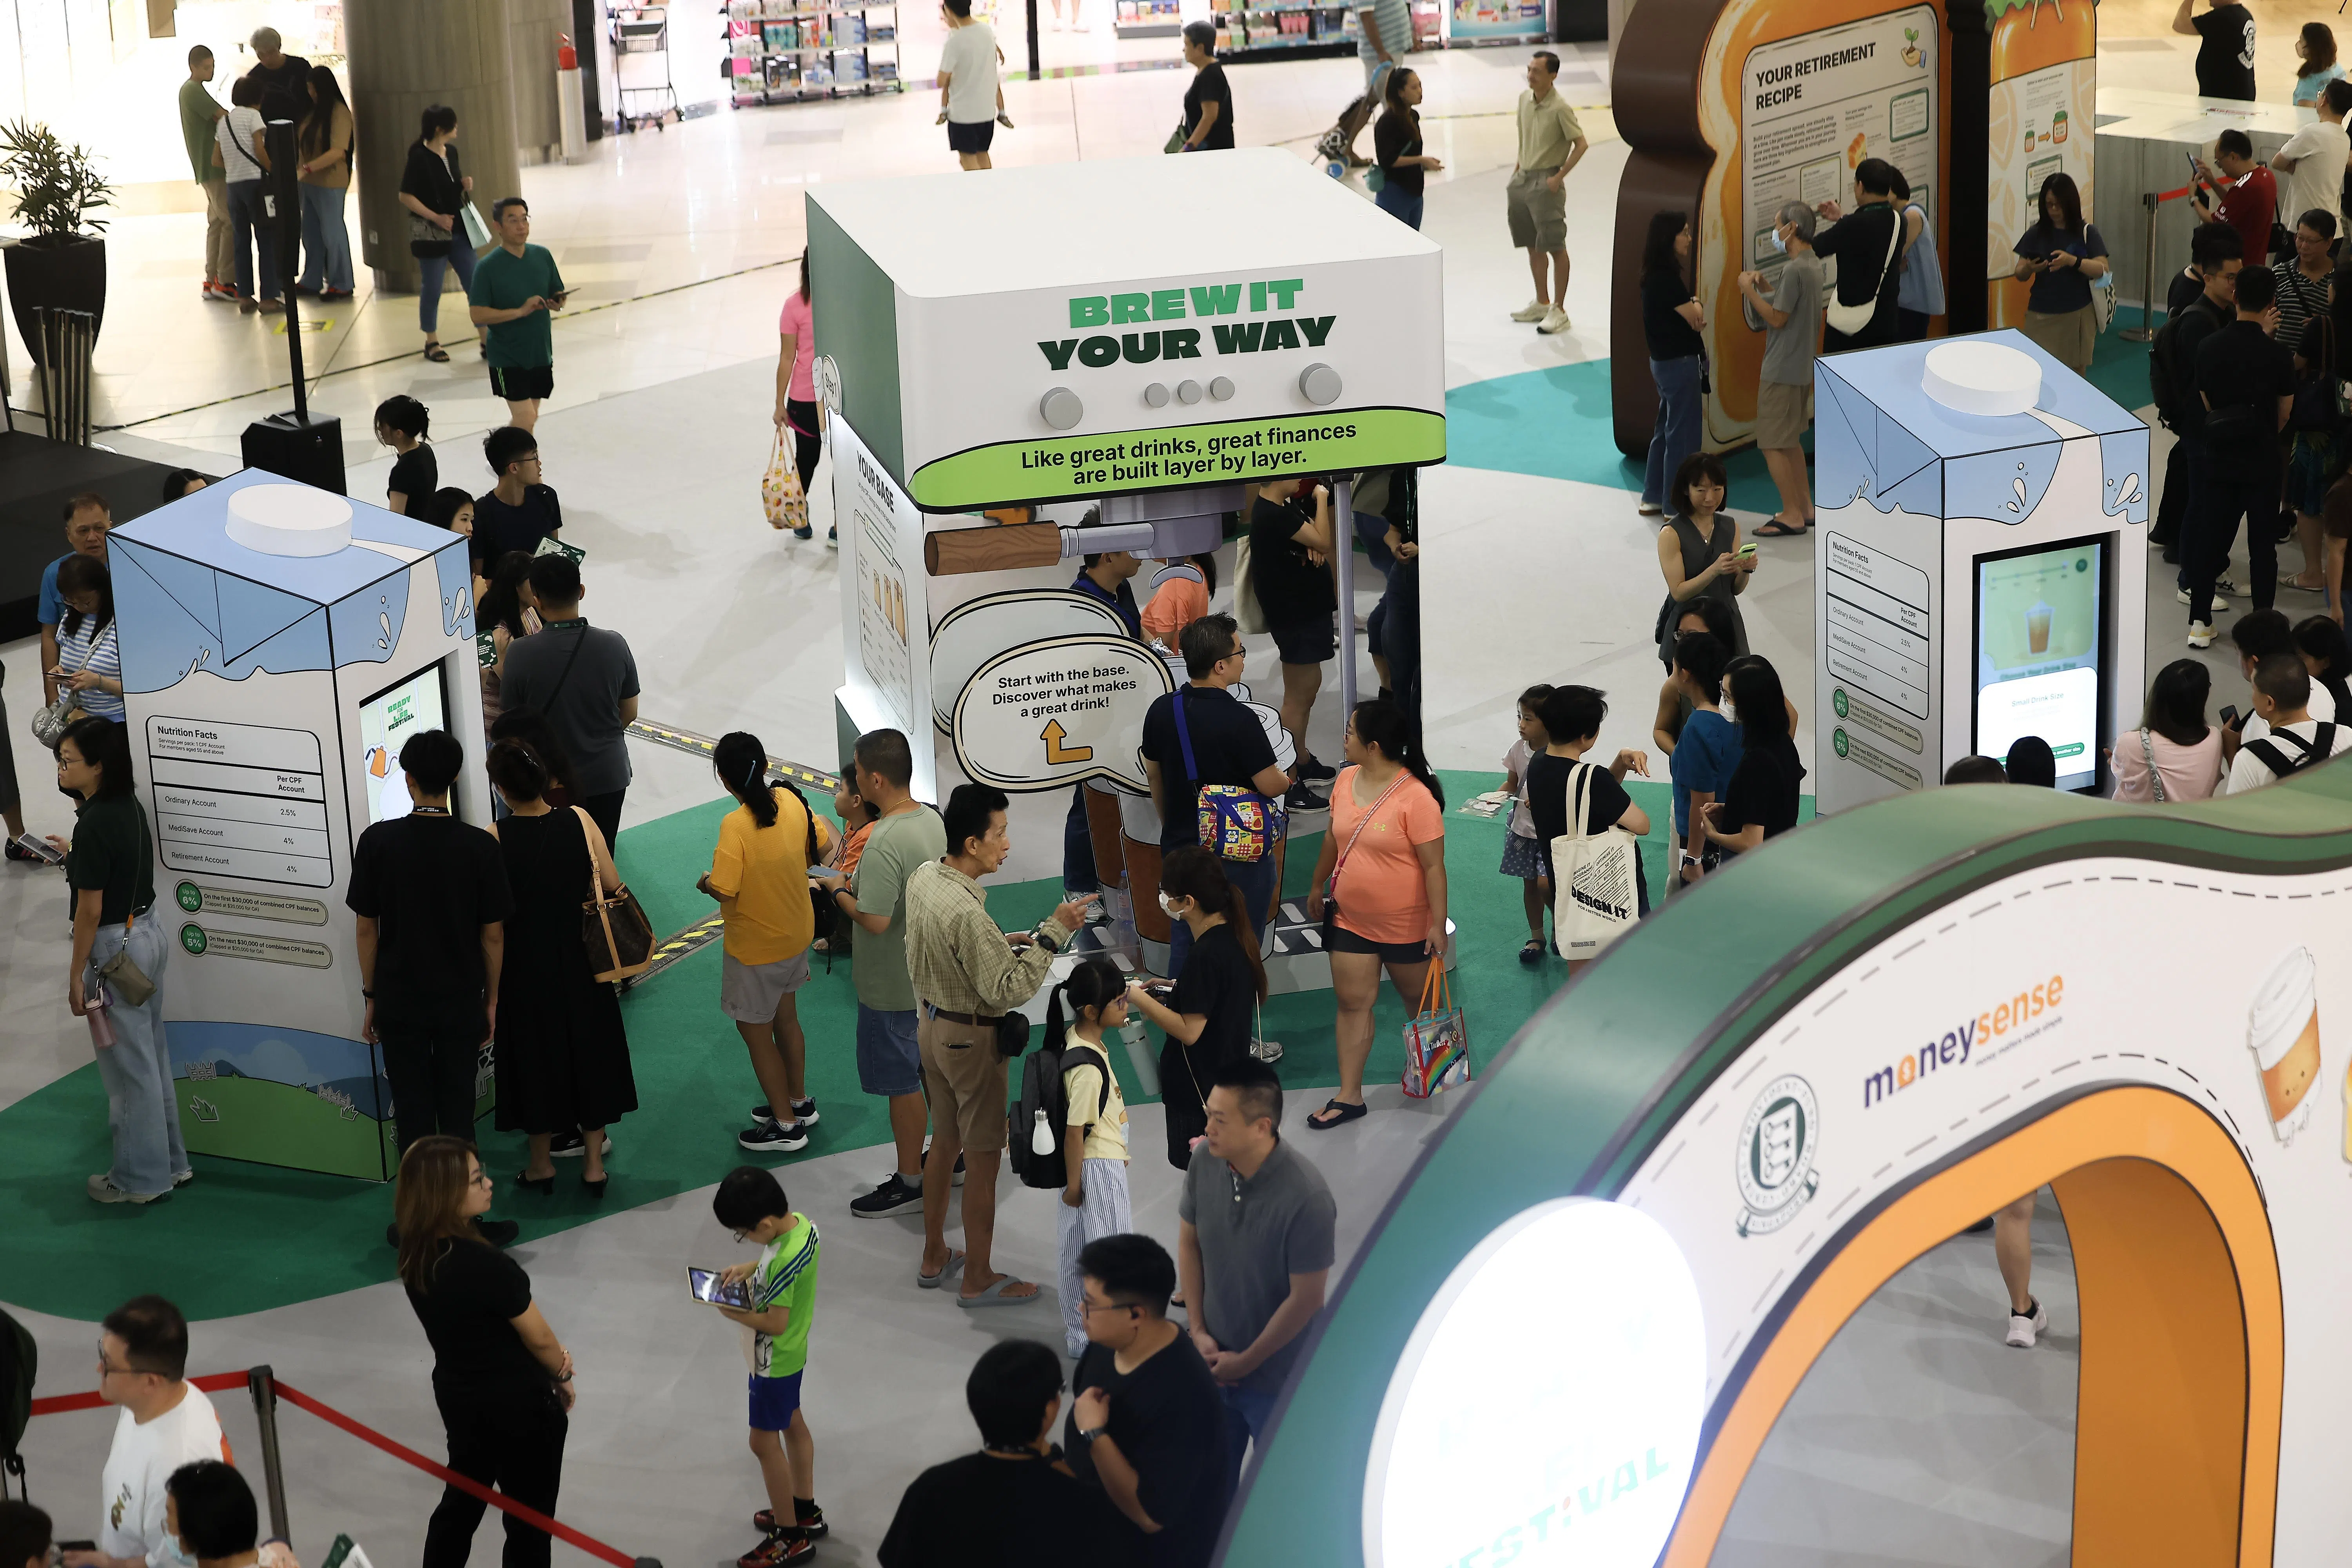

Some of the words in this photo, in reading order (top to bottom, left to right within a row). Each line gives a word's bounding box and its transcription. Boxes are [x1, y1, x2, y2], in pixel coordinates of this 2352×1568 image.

[1756, 65, 1792, 87] YOUR
[1795, 42, 1876, 77] RETIREMENT
[1756, 83, 1802, 110] RECIPE
[1069, 284, 1242, 328] BREW
[1250, 278, 1303, 312] IT
[1038, 328, 1201, 370] YOUR
[1212, 316, 1337, 355] WAY
[825, 372, 834, 397] Step
[834, 382, 837, 397] 1
[1022, 450, 1064, 469] Like
[1070, 443, 1125, 468] great
[1131, 437, 1202, 458] drinks,
[1207, 430, 1262, 455] great
[1267, 425, 1356, 445] finances
[1074, 469, 1107, 485] are
[1112, 461, 1159, 481] built
[1164, 458, 1215, 479] layer
[1221, 453, 1246, 474] by
[1252, 450, 1307, 470] layer.
[857, 450, 876, 490] YOUR
[876, 473, 894, 514] BASE
[1833, 541, 1854, 557] Nutrition
[1855, 550, 1869, 564] Facts
[1833, 606, 1849, 620] Ordinary
[1848, 613, 1864, 626] Account
[1900, 615, 1917, 628] Account
[1907, 610, 1916, 619] CPF
[1833, 632, 1850, 646] MediSave
[1850, 641, 1866, 653] Account
[1901, 638, 1911, 648] 2.5%
[998, 675, 1032, 688] Start
[1034, 671, 1064, 684] with
[1067, 669, 1089, 681] the
[1093, 666, 1129, 678] base.
[1833, 659, 1852, 673] Retirement
[1852, 668, 1867, 681] Account
[993, 690, 1053, 705] Discover
[1055, 684, 1089, 697] what
[1092, 680, 1136, 693] makes
[387, 695, 411, 713] READY
[1020, 708, 1028, 717] a
[1032, 702, 1067, 719] great
[1070, 696, 1109, 711] drink!
[1837, 701, 1846, 712] 6%
[2011, 698, 2030, 707] Small
[2031, 695, 2049, 704] Drink
[157, 725, 193, 737] Nutrition
[194, 729, 218, 740] Facts
[1837, 740, 1846, 751] 5%
[278, 784, 305, 793] Account
[165, 795, 191, 806] Ordinary
[192, 799, 217, 808] Account
[280, 808, 296, 817] 2.5%
[168, 823, 197, 833] MediSave
[198, 827, 223, 837] Account
[171, 851, 203, 862] Retirement
[204, 855, 229, 865] Account
[1596, 851, 1610, 866] OPTIMISE
[1610, 852, 1619, 863] PRINT
[1573, 866, 1587, 876] IMAGINE
[1603, 870, 1613, 881] BUILD
[182, 896, 197, 906] 6%
[1600, 886, 1615, 900] LAUNCH
[231, 896, 253, 904] $30,000
[296, 904, 319, 913] balances
[1572, 885, 1613, 915] DESIGN
[1615, 906, 1627, 920] IT
[1601, 914, 1617, 922] WORLD
[187, 938, 201, 947] 5%
[237, 938, 258, 947] $30,000
[301, 947, 325, 956] balances
[1864, 975, 2063, 1109] moneysense
